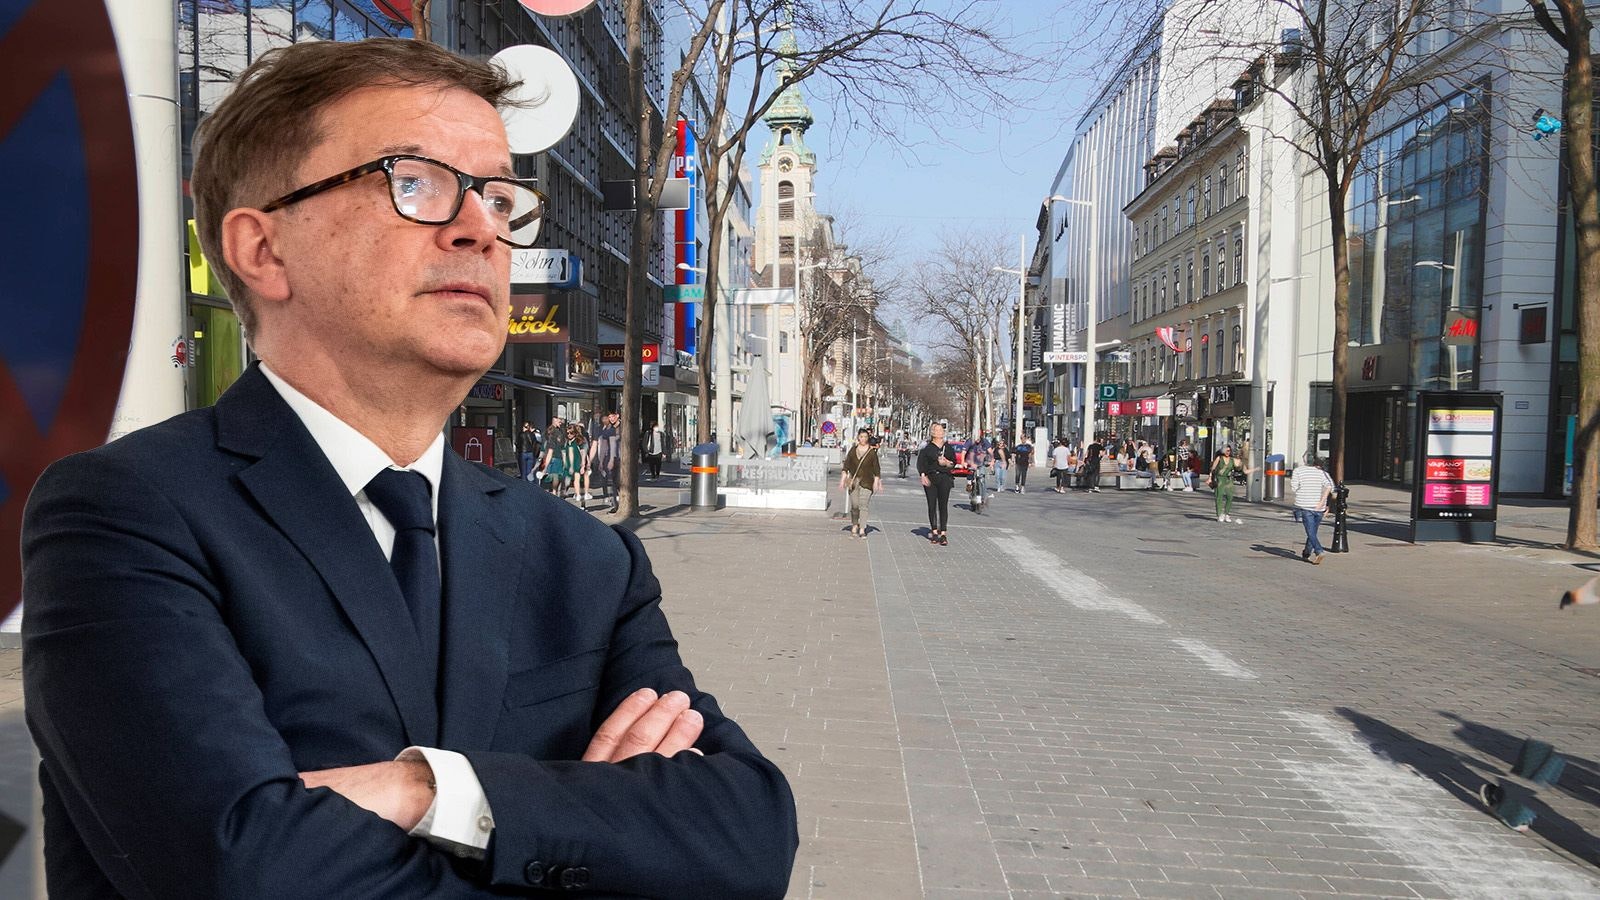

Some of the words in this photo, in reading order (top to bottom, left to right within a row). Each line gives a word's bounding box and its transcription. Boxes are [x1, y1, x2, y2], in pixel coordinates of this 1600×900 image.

[508, 304, 560, 335] röck
[1448, 318, 1478, 337] H&M
[603, 348, 652, 358] EDUO
[1055, 353, 1087, 361] INTERSPO
[1103, 386, 1115, 397] D
[741, 469, 823, 482] RESTAURANT
